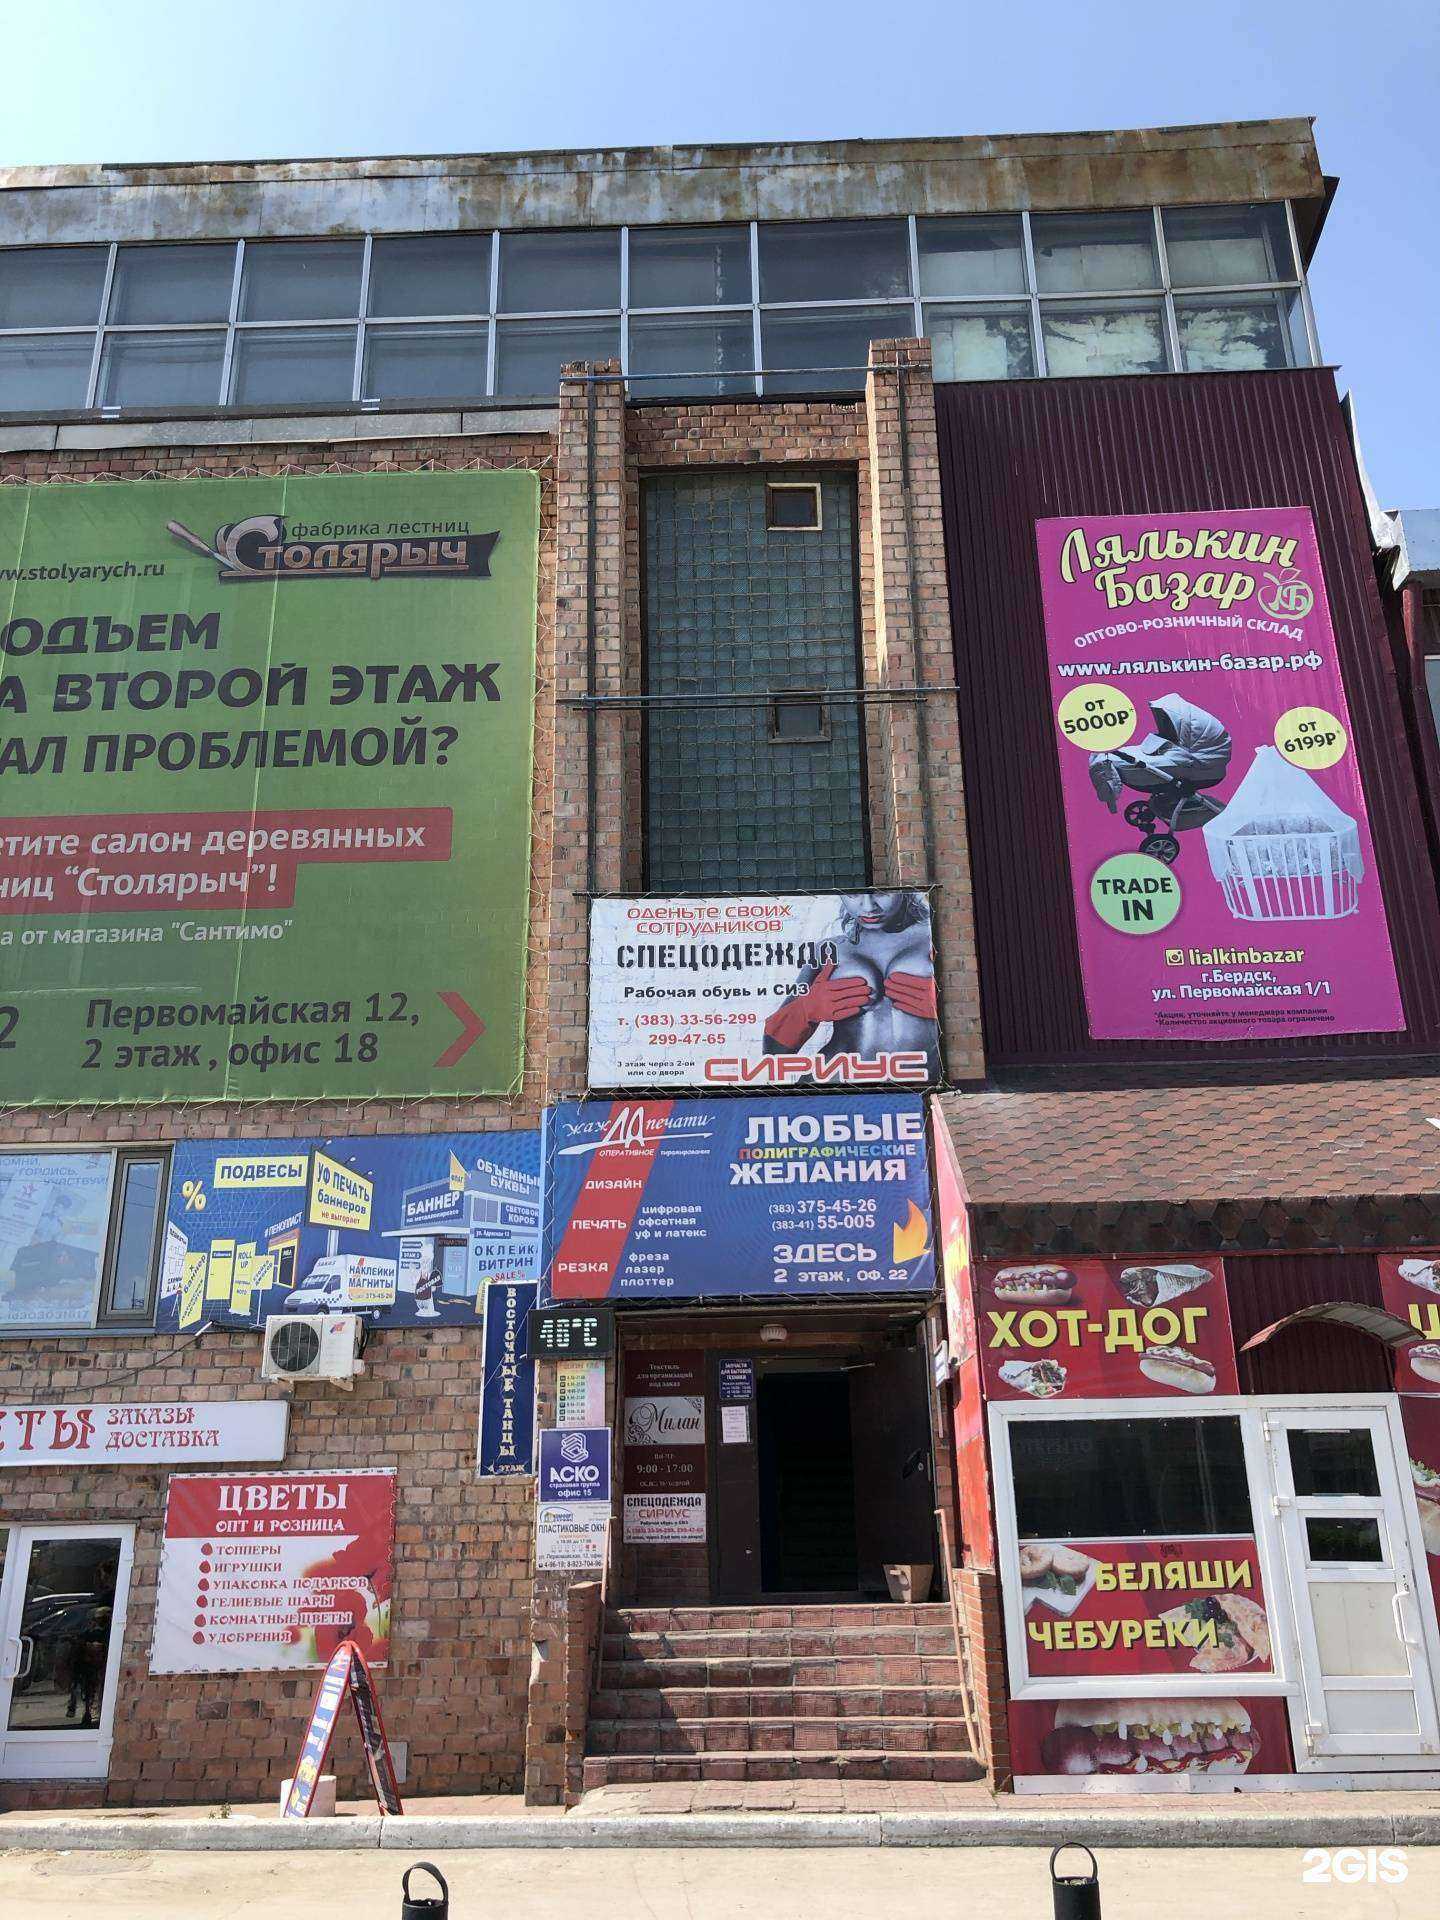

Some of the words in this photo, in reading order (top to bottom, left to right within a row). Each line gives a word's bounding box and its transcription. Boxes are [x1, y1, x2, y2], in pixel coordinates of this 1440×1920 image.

[291, 520, 380, 541] фабрика
[386, 518, 470, 537] лестниц
[216, 515, 470, 580] Столярыч
[1060, 527, 1299, 584] Лялькин
[1094, 565, 1256, 612] Базар
[1074, 614, 1243, 648] ОПТОВО-РОЗНИЧНЫЙ
[1246, 617, 1304, 641] СКЛАД
[1057, 650, 1323, 678] www.лялькин-базар.рф
[53, 662, 308, 713] ВТОРОЙ
[329, 662, 501, 706] ЭТАЖ
[0, 736, 67, 775] АЛ
[83, 716, 459, 773] ПРОБЛЕМОЙ?
[0, 831, 80, 857] тите
[91, 828, 191, 854] салон
[201, 826, 426, 857] деревянных
[1097, 876, 1173, 896] TRADE
[1121, 899, 1154, 921] IN
[21, 930, 47, 945] от
[53, 926, 163, 945] магазина
[172, 920, 293, 942] "Сантимо"
[617, 942, 838, 971] СПЕЦОДЕЖДА
[1188, 948, 1305, 966] lialkinbazar
[1201, 969, 1277, 985] г.Бердск,
[624, 986, 696, 999] Рабочая
[702, 985, 751, 999] обувь
[757, 986, 767, 996] и
[773, 983, 810, 997] СИЗ
[1152, 986, 1177, 1001] ул.
[1179, 983, 1302, 1001] Первомайская
[1304, 981, 1331, 997] 1/1
[86, 999, 351, 1034] Первомайская
[365, 992, 420, 1027] 12,
[618, 1016, 629, 1027] т.
[634, 1013, 675, 1029] (383)
[680, 1013, 757, 1026] 33-56-299
[648, 1032, 726, 1045] 299-47-65
[82, 1037, 102, 1070] 2
[228, 1039, 321, 1072] офис
[334, 1033, 378, 1063] 18
[703, 1051, 928, 1083] СИРИУС
[743, 1112, 923, 1145] ЛЮБЫЕ
[739, 1144, 917, 1160] ПОЛИГРАФИЧЕСКИЕ
[220, 1162, 303, 1181] ПОДВЕСЫ
[730, 1159, 907, 1185] ЖЕЛАНИЯ
[316, 1162, 331, 1185] УФ
[332, 1171, 371, 1202] ПЕЧАТЬ
[490, 1174, 530, 1195] БУКВЫ
[585, 1177, 643, 1190] ДИЗАЙН
[317, 1188, 367, 1216] баннеров
[406, 1191, 460, 1217] БАННЕР
[641, 1203, 702, 1217] цифровая
[769, 1203, 796, 1215] (383)
[797, 1199, 878, 1214] 375-45-26
[321, 1210, 331, 1220] не
[508, 1213, 536, 1225] КОРОБ
[638, 1216, 697, 1228] офсетная
[772, 1219, 815, 1231] (383-41)
[817, 1215, 876, 1229] 55-005
[572, 1218, 627, 1230] ПЕЧАТЬ
[664, 1227, 708, 1238] латекс
[474, 1245, 539, 1256] ОКЛЕЙК
[628, 1252, 670, 1263] фреза
[773, 1243, 878, 1265] ЗДЕСЬ
[349, 1265, 395, 1277] НАКЛЕЙКИ
[478, 1257, 534, 1271] ВИТРИН
[558, 1262, 609, 1273] РЕЗКА
[625, 1264, 665, 1275] лазер
[348, 1277, 393, 1288] МАГНИТЫ
[620, 1275, 674, 1287] плоттер
[773, 1268, 788, 1282] 2
[887, 1268, 908, 1281] 22
[987, 1306, 1210, 1353] ХОТ-ДОГ
[501, 1287, 517, 1392] ВОСТОЧНЫЕ
[0, 1409, 96, 1451] ТЫ
[106, 1407, 196, 1425] ЗАКАЗЫ
[500, 1398, 516, 1456] ТАНЦЫ
[104, 1429, 219, 1452] ДОСТАВКА
[550, 1466, 600, 1482] АСКО
[637, 1464, 658, 1473] 9:00
[667, 1463, 694, 1473] 17:00
[217, 1483, 348, 1516] ЦВЕТЫ
[557, 1489, 581, 1498] офис
[583, 1488, 592, 1496] 15
[626, 1496, 702, 1507] СПЕЦОДЕЖДА
[639, 1508, 690, 1518] СИРИУС
[216, 1519, 249, 1533] ОПТ
[255, 1519, 264, 1532] И
[270, 1517, 345, 1534] РОЗНИЦА
[539, 1523, 590, 1533] ПЛАСТИКОВЫЕ
[216, 1544, 282, 1556] ТОППЕРЫ
[213, 1561, 282, 1573] ИГРУШКИ
[212, 1578, 288, 1590] УПАКОВКА
[293, 1576, 368, 1589] ПОДАРКОВ
[1095, 1559, 1252, 1592] БЕЛЯШИ
[211, 1596, 283, 1608] ГЕЛИЕВЫЕ
[287, 1594, 333, 1607] ШАРЫ
[209, 1613, 297, 1626] КОМНАТНЫЕ
[300, 1611, 352, 1625] ЦВЕТЫ
[208, 1631, 292, 1644] УДОБРЕНИЯ
[1028, 1618, 1220, 1651] ЧЕБУРЕКИ
